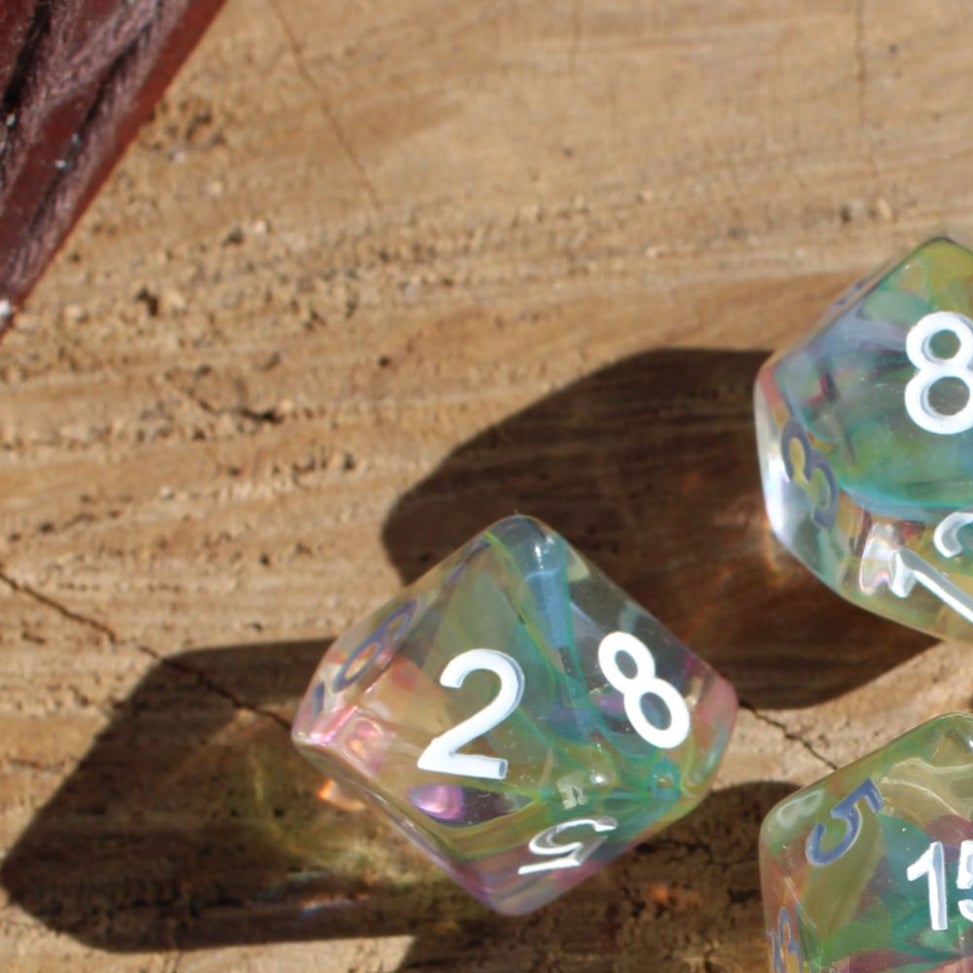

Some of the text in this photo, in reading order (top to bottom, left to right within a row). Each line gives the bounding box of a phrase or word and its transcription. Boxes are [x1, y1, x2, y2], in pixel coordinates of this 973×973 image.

[417, 648, 525, 780] 2
[597, 631, 690, 750] 8
[805, 778, 884, 867] 5
